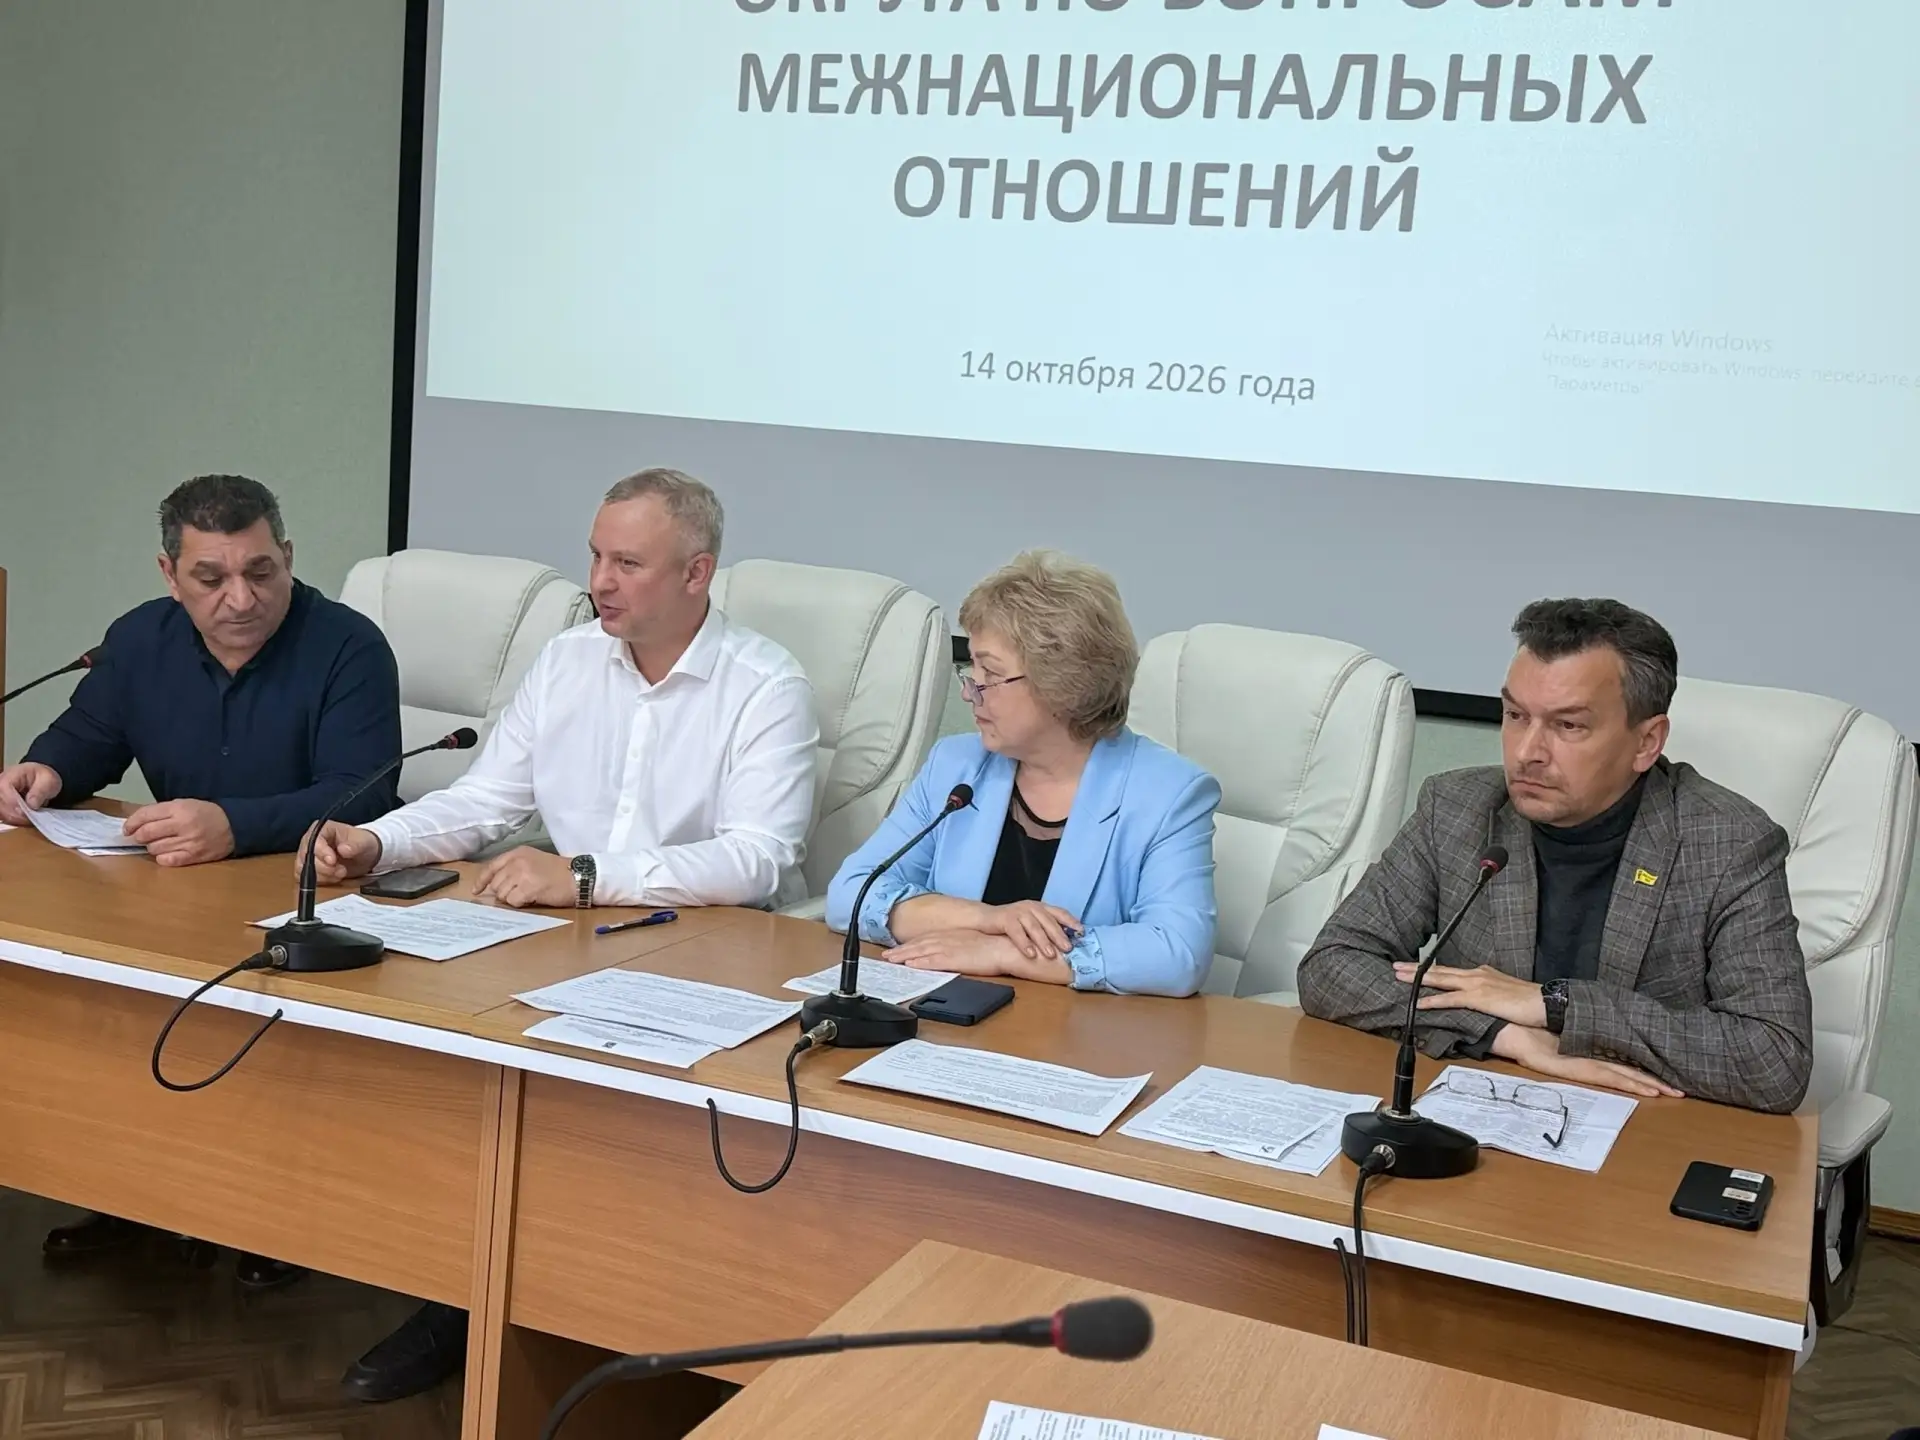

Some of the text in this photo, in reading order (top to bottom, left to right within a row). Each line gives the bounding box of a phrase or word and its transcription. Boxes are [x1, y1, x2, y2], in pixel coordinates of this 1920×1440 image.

[738, 53, 1653, 134] МЕЖНАЦИОНАЛЬНЫХ
[894, 146, 1420, 232] ОТНОШЕНИЙ
[1543, 323, 1775, 354] Активация Windows
[960, 350, 1316, 406] 14 октября 2026 года
